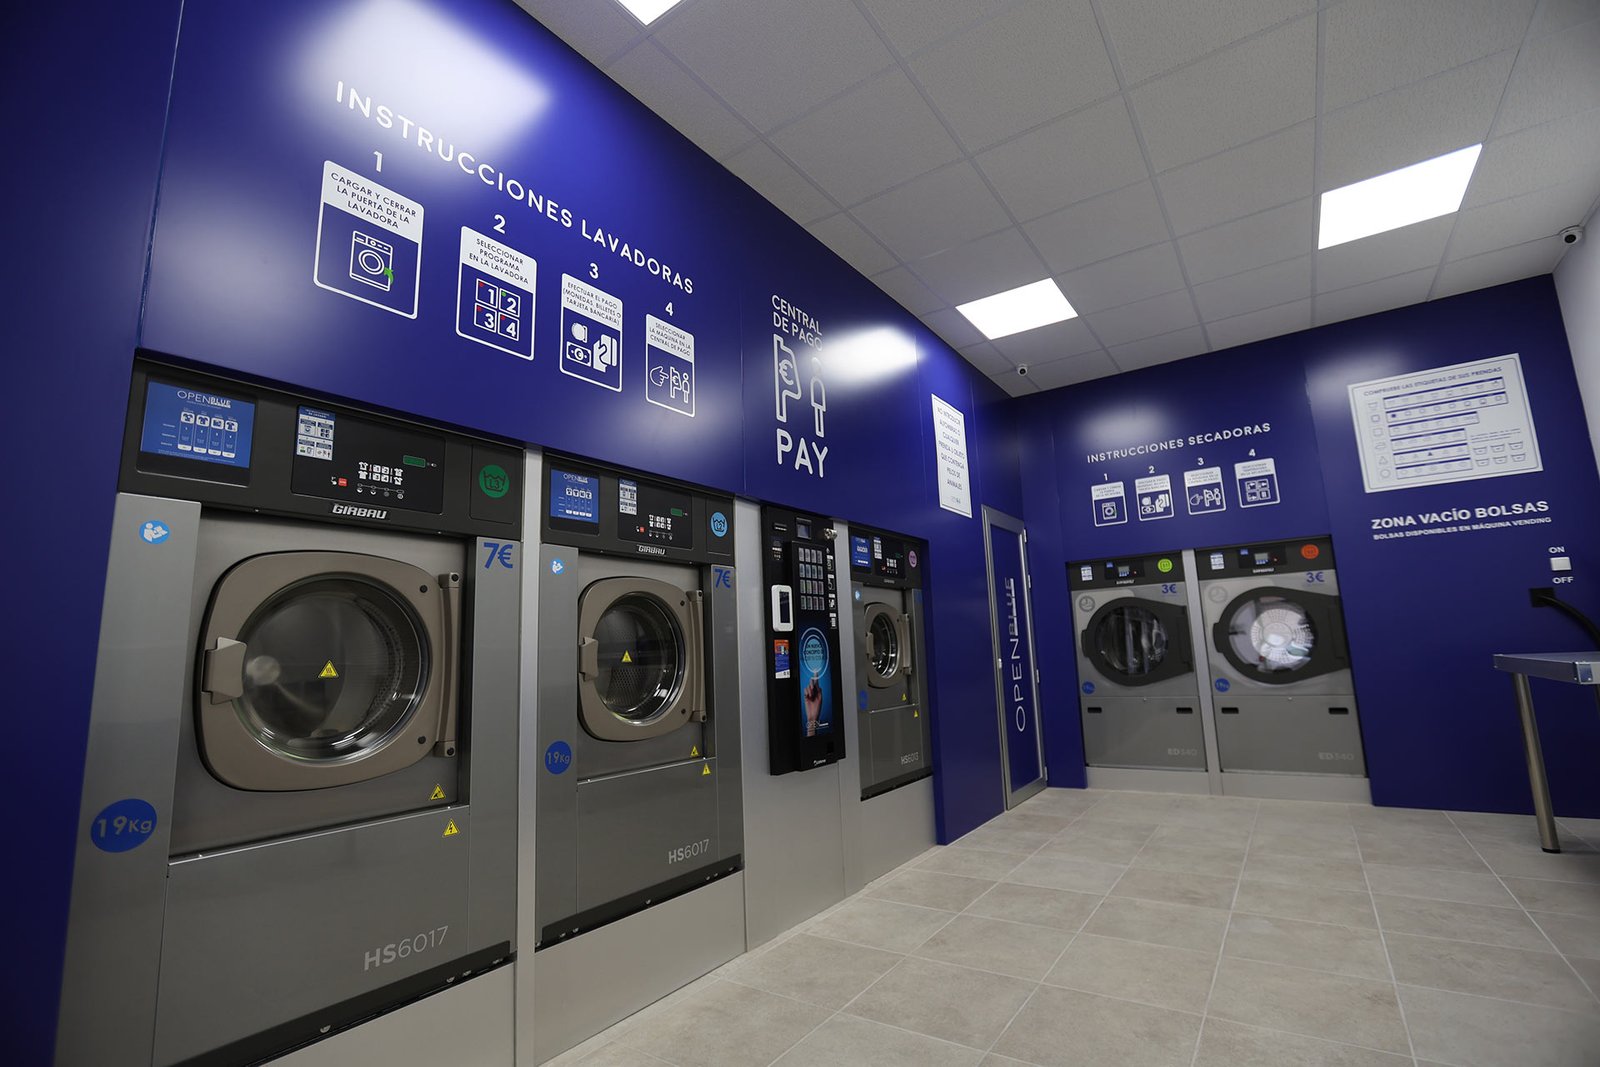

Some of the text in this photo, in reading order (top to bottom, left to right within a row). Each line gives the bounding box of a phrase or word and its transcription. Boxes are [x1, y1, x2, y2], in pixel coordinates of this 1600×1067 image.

[373, 150, 383, 173] 1
[330, 172, 416, 217] CARGAR Y CERRAR
[336, 81, 694, 294] INSTRUCCIONES LAVADORAS
[336, 185, 410, 224] LA PUERTA DE LA
[347, 200, 399, 229] LAVADORA
[493, 214, 506, 234] 2
[476, 238, 524, 265] SELECCIONAR
[479, 248, 520, 271] PROGRAMA
[469, 252, 529, 284] EN LA LAVADORA
[589, 262, 599, 279] 3
[488, 288, 517, 313] 1 2
[567, 281, 594, 298] EFECTUAR
[601, 298, 617, 310] PAGO
[566, 296, 620, 326] TARJETA BANCARIA)
[595, 303, 616, 316] BILLETES
[665, 302, 673, 316] 4
[771, 294, 823, 336] CENTRAL
[484, 312, 516, 337] 3 4
[655, 322, 685, 340] SELECCIONAR
[773, 311, 823, 352] DE PAGO
[650, 334, 670, 348] CENTRAL
[677, 346, 690, 356] PAGO
[1363, 385, 1400, 396] COMPRUEBE
[1414, 377, 1446, 388] ETIQUETAS
[1471, 366, 1502, 377] PRENDAS
[776, 428, 828, 478] PAY
[1087, 422, 1271, 464] INSTRUCCIONES SECADORAS
[1248, 448, 1256, 457] 4
[1148, 465, 1155, 474] 2
[1197, 457, 1204, 466] 3
[1103, 473, 1108, 481] 1
[332, 503, 388, 520] GIRBAU
[1371, 515, 1417, 529] ZONA
[1475, 500, 1549, 519] BOLSAS
[1372, 516, 1551, 540] BOLSAS DISPONIBLES EN MÁQUINA VENDING
[483, 542, 513, 569] 7€
[638, 545, 666, 555] GIRBAU
[1548, 546, 1565, 554] ON
[714, 568, 731, 588] 7€
[1161, 583, 1177, 594] 3€
[1306, 571, 1325, 583] 3€
[1552, 576, 1574, 584] OFF
[668, 839, 710, 865] HS6017
[364, 925, 449, 971] HS6017
